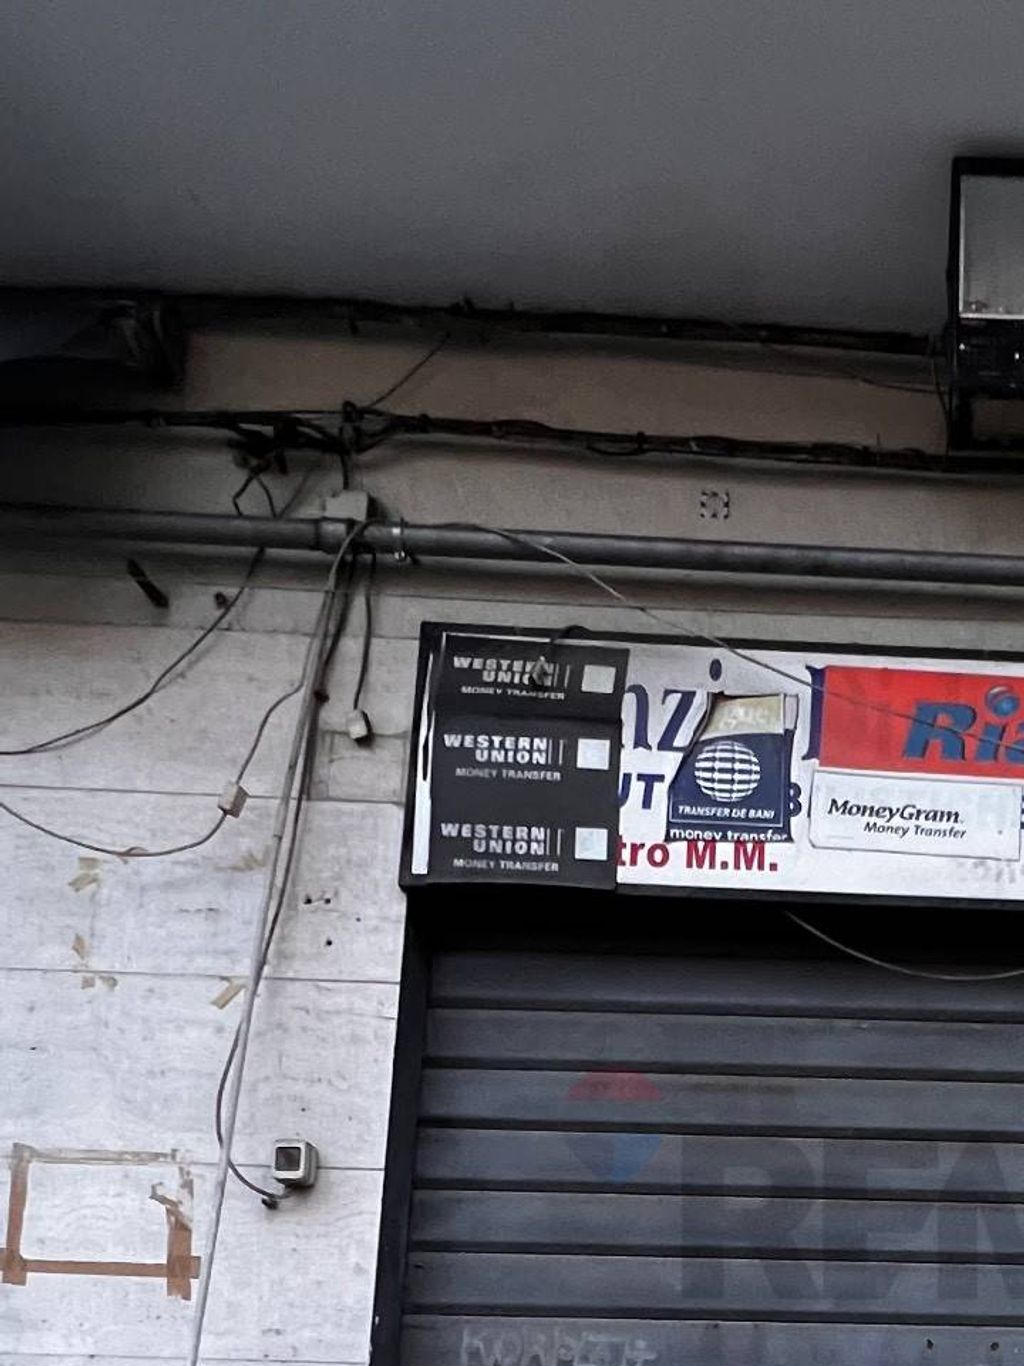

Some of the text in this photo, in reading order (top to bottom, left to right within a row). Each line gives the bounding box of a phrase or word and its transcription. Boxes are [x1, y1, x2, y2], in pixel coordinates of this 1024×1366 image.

[461, 686, 502, 695] MONEY
[443, 734, 547, 750] WESTERN
[475, 750, 547, 765] UNION
[455, 768, 561, 781] MONEY TRANSFER
[678, 805, 775, 820] TRANSFER DE BANI
[827, 798, 961, 824] MoneyGram
[441, 823, 545, 841] WESTERN
[669, 828, 722, 841] money
[864, 821, 967, 840] Money Transfer
[473, 839, 545, 856] UNION
[616, 838, 779, 872] tro M.M.
[453, 858, 559, 872] MONEY TRANSFER
